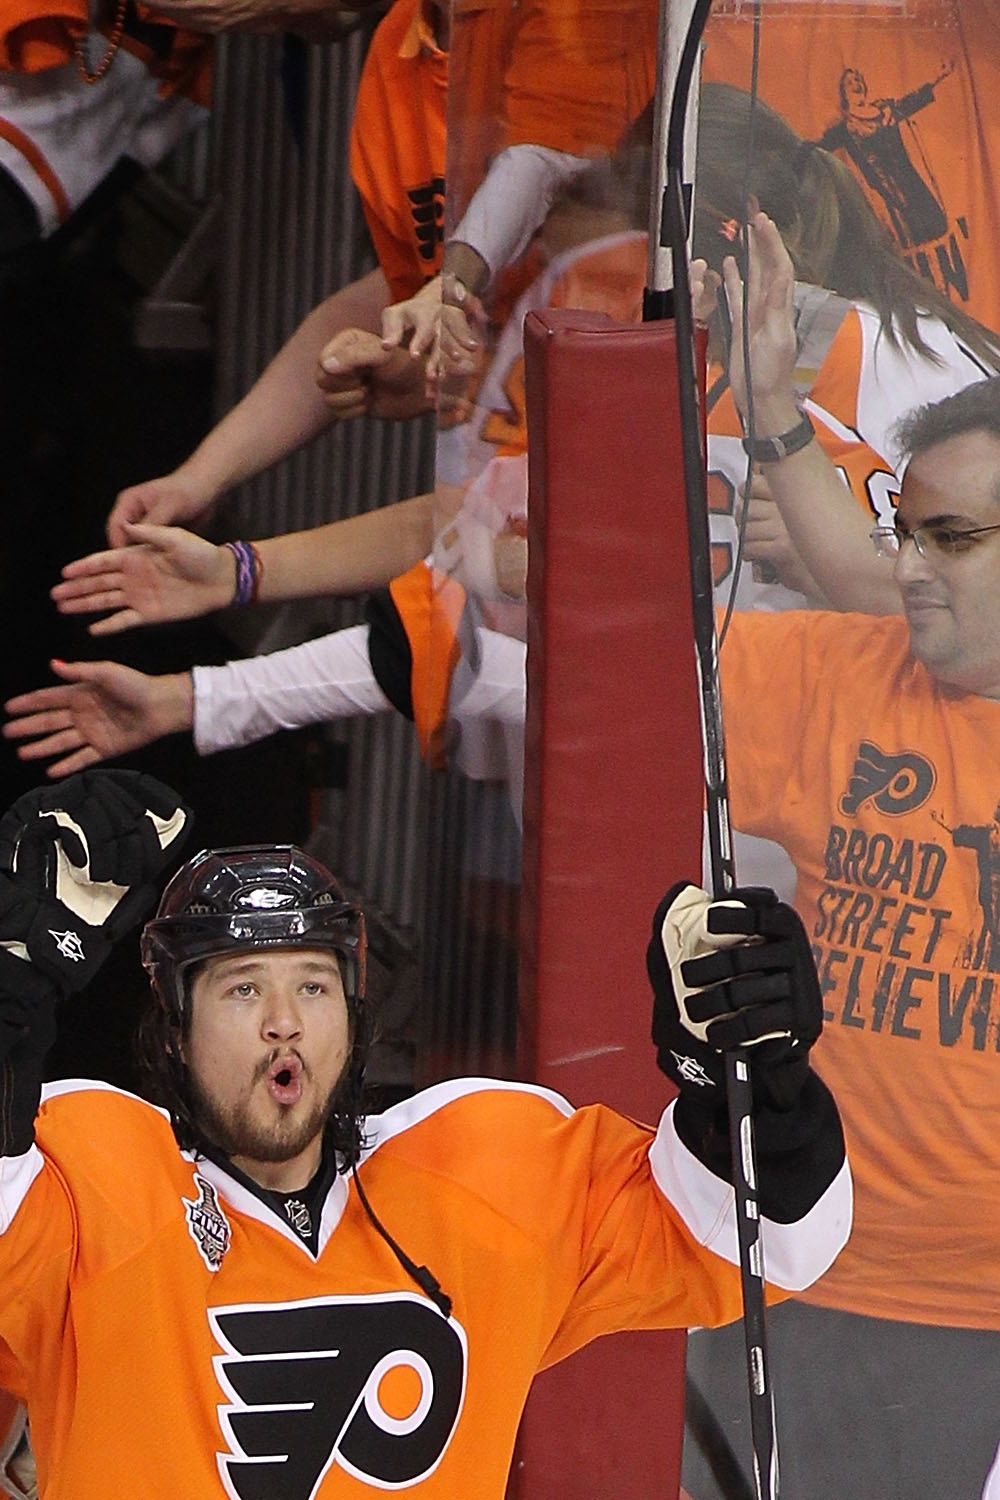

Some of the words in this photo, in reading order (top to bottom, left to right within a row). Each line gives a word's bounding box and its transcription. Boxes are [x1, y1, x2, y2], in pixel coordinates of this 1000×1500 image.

[824, 824, 947, 901] BROAD
[813, 886, 952, 964] STREET
[812, 943, 1000, 1053] ELIEVI
